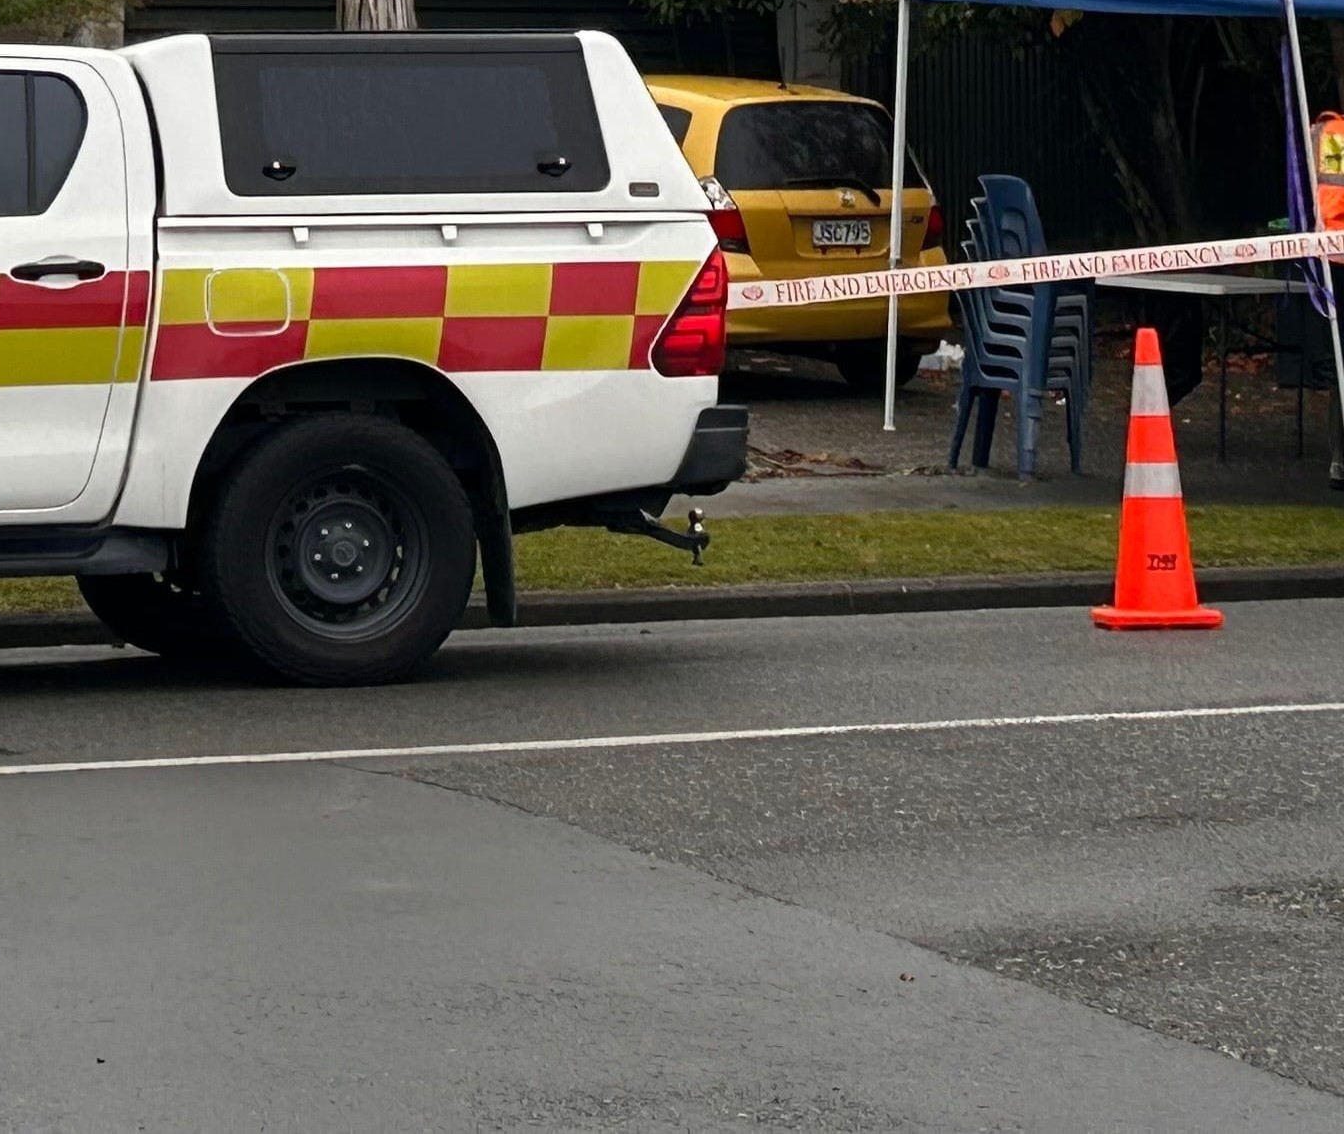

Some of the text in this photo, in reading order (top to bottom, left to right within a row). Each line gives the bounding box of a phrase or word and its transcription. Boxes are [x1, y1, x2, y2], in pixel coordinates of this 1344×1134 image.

[1022, 246, 1223, 281] FIRE AND EMERGENCY
[1269, 240, 1307, 259] FIRE
[776, 268, 975, 303] FIRE AND EMERGENCY
